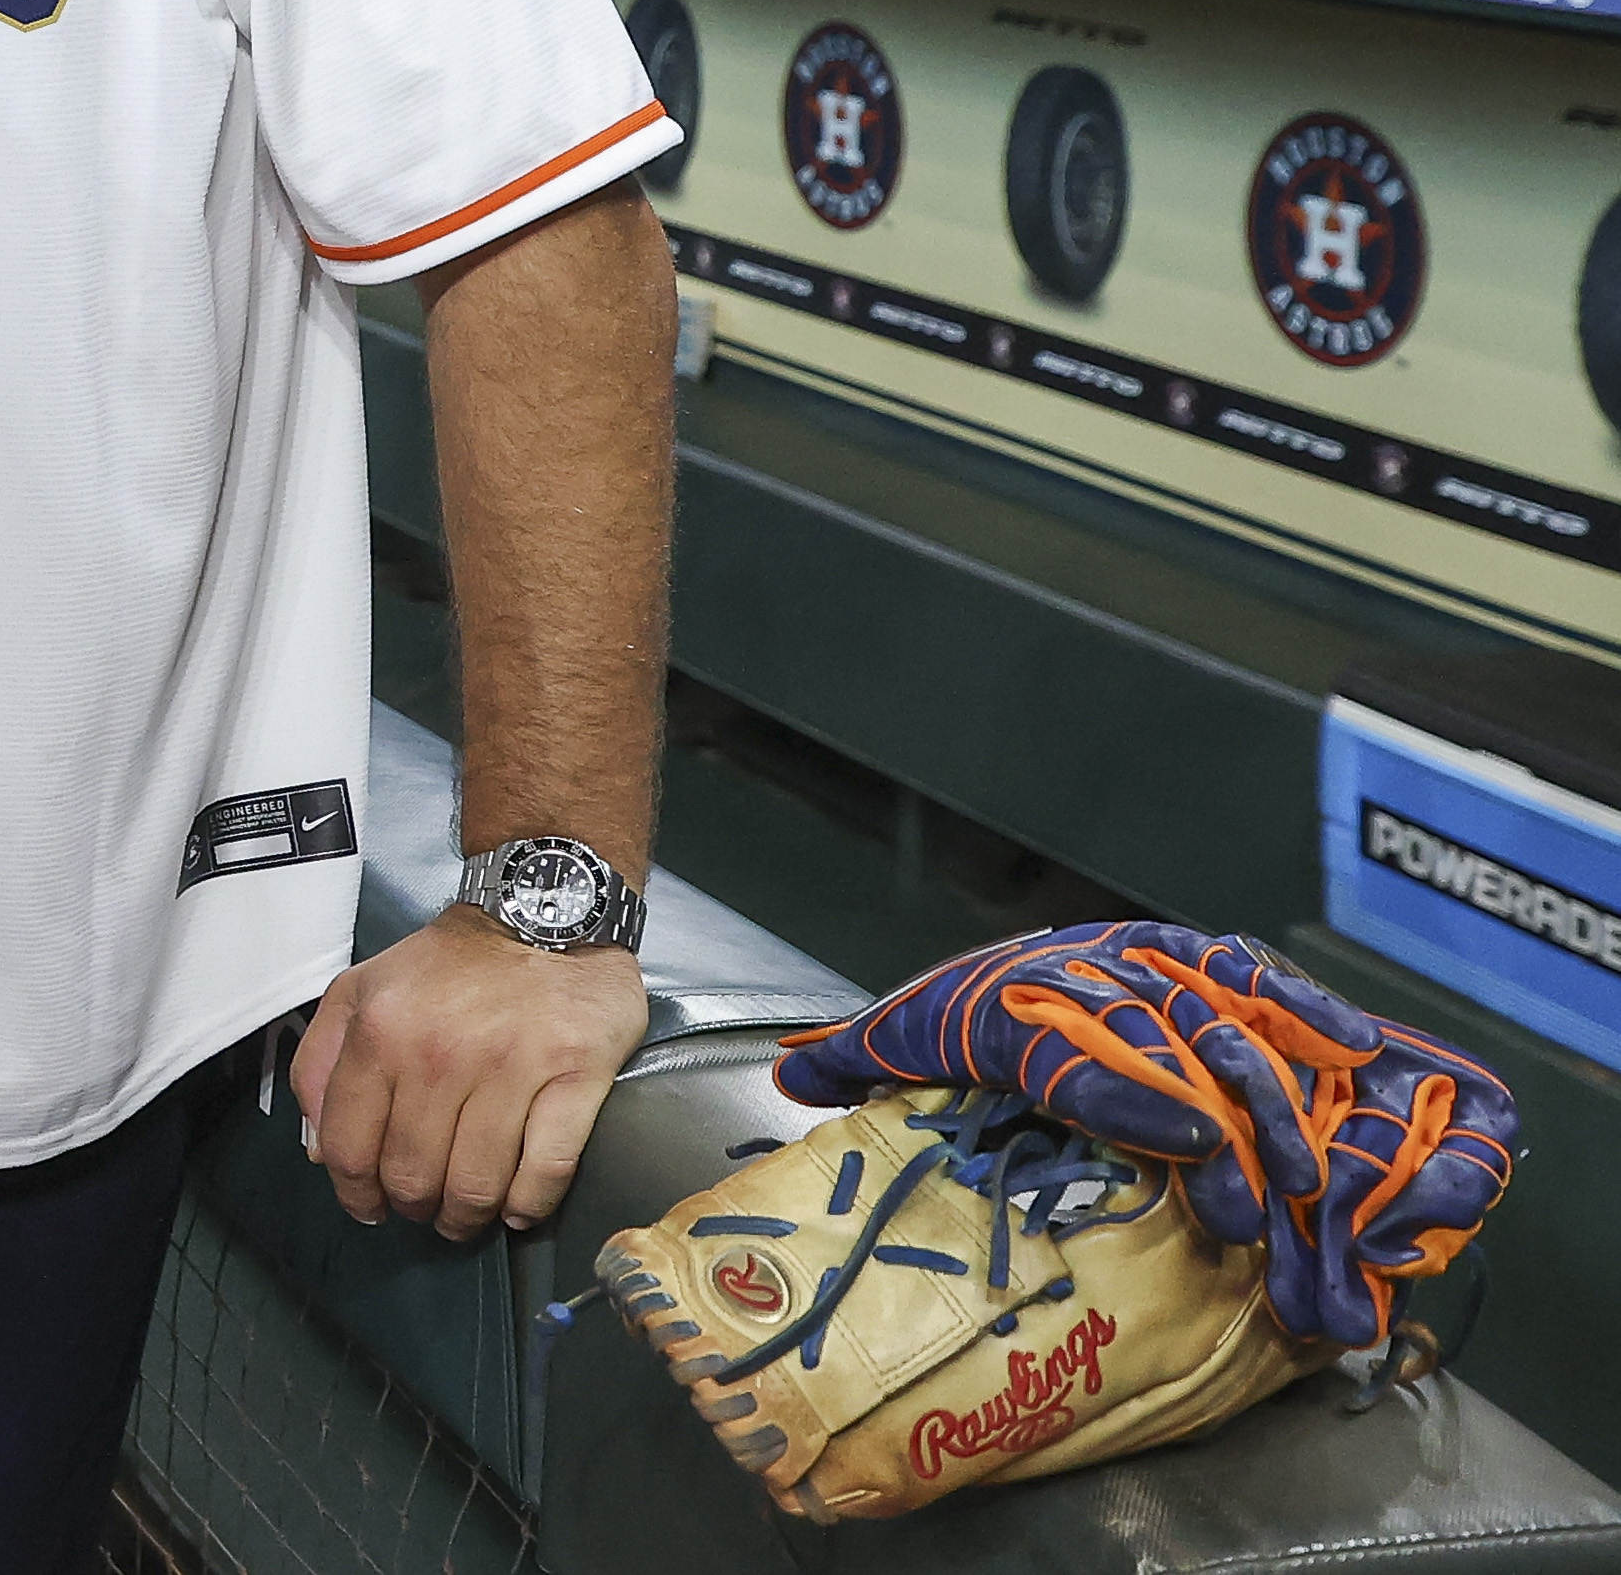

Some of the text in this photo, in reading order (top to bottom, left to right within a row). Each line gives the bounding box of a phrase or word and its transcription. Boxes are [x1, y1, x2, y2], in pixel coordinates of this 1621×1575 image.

[1295, 193, 1370, 292] H
[209, 799, 285, 823] ENGINEERED
[908, 1307, 1118, 1481] Rawlings
